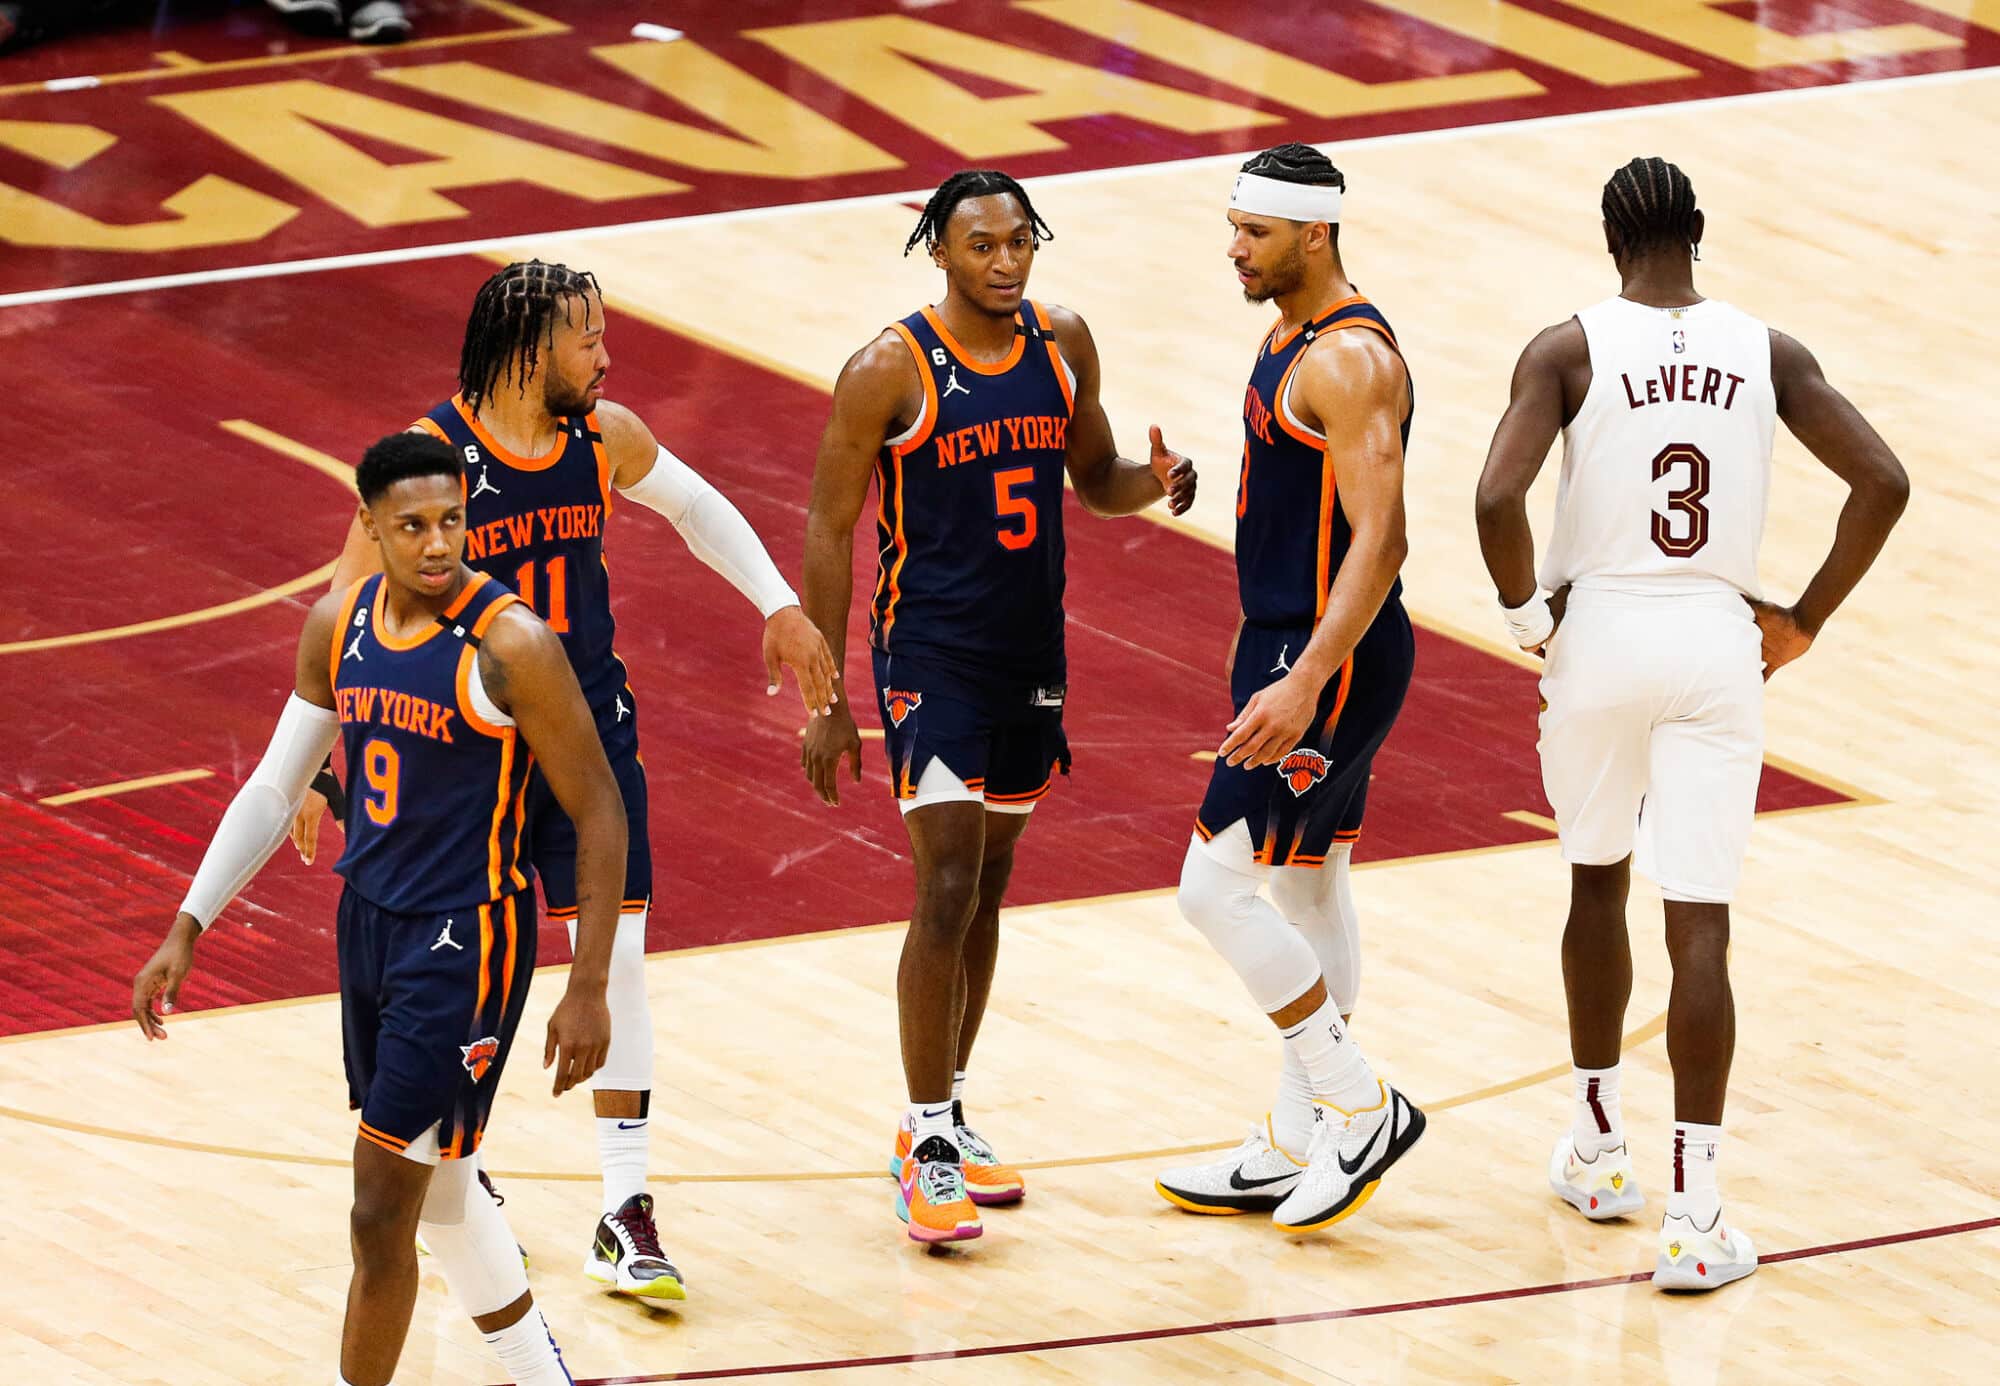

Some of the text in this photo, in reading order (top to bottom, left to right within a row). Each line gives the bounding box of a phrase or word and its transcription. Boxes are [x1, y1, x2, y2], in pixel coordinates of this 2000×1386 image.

[931, 348, 947, 365] 6
[464, 444, 480, 464] 6
[934, 416, 1068, 469] NEW YORK
[993, 466, 1037, 551] 5
[1650, 443, 1710, 559] 3
[464, 505, 601, 560] NEW YORK
[353, 607, 368, 627] 6
[516, 556, 569, 633] 11
[380, 687, 455, 744] YORK
[364, 739, 400, 826] 9
